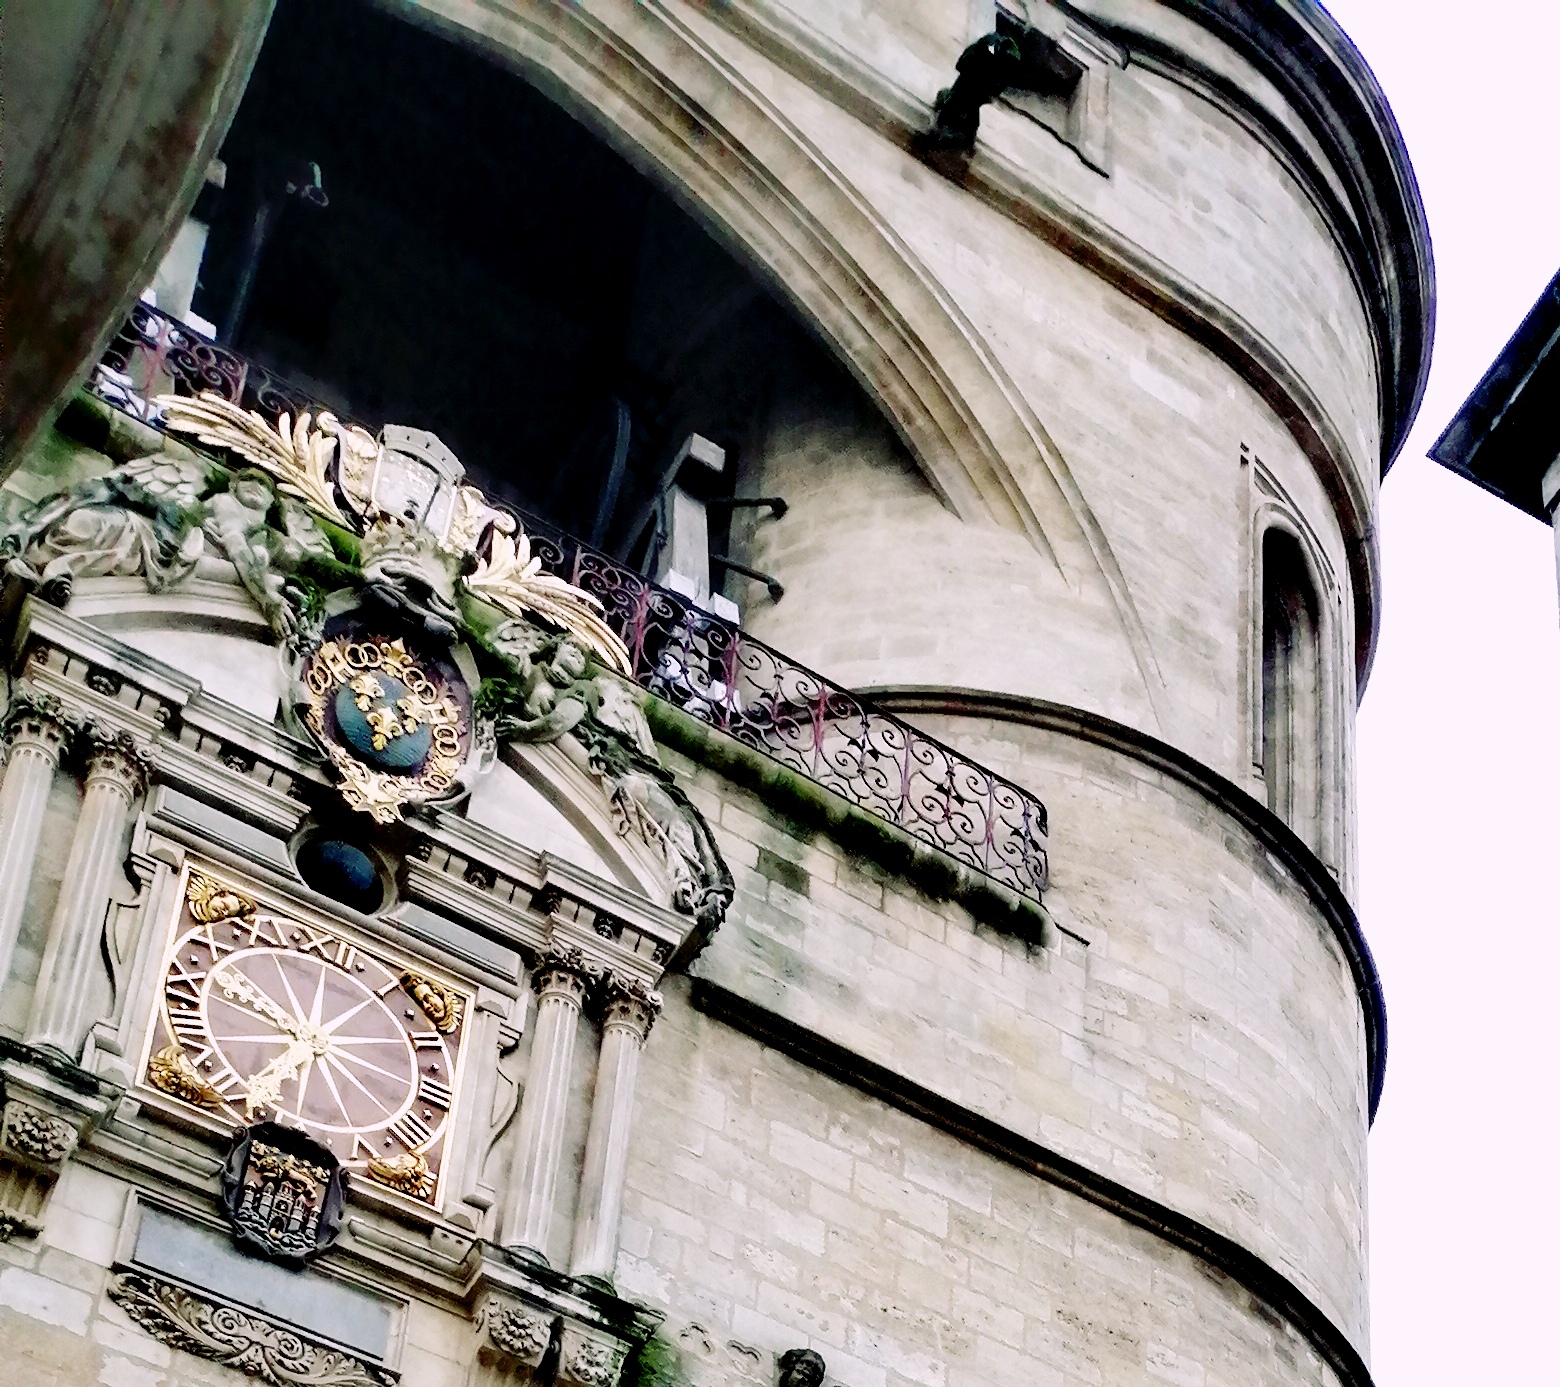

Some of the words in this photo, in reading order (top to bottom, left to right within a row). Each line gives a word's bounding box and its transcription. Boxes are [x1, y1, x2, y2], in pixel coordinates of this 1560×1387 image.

[188, 924, 235, 962] X
[300, 926, 358, 972] XII
[411, 1031, 442, 1049] II
[419, 1075, 450, 1109] III
